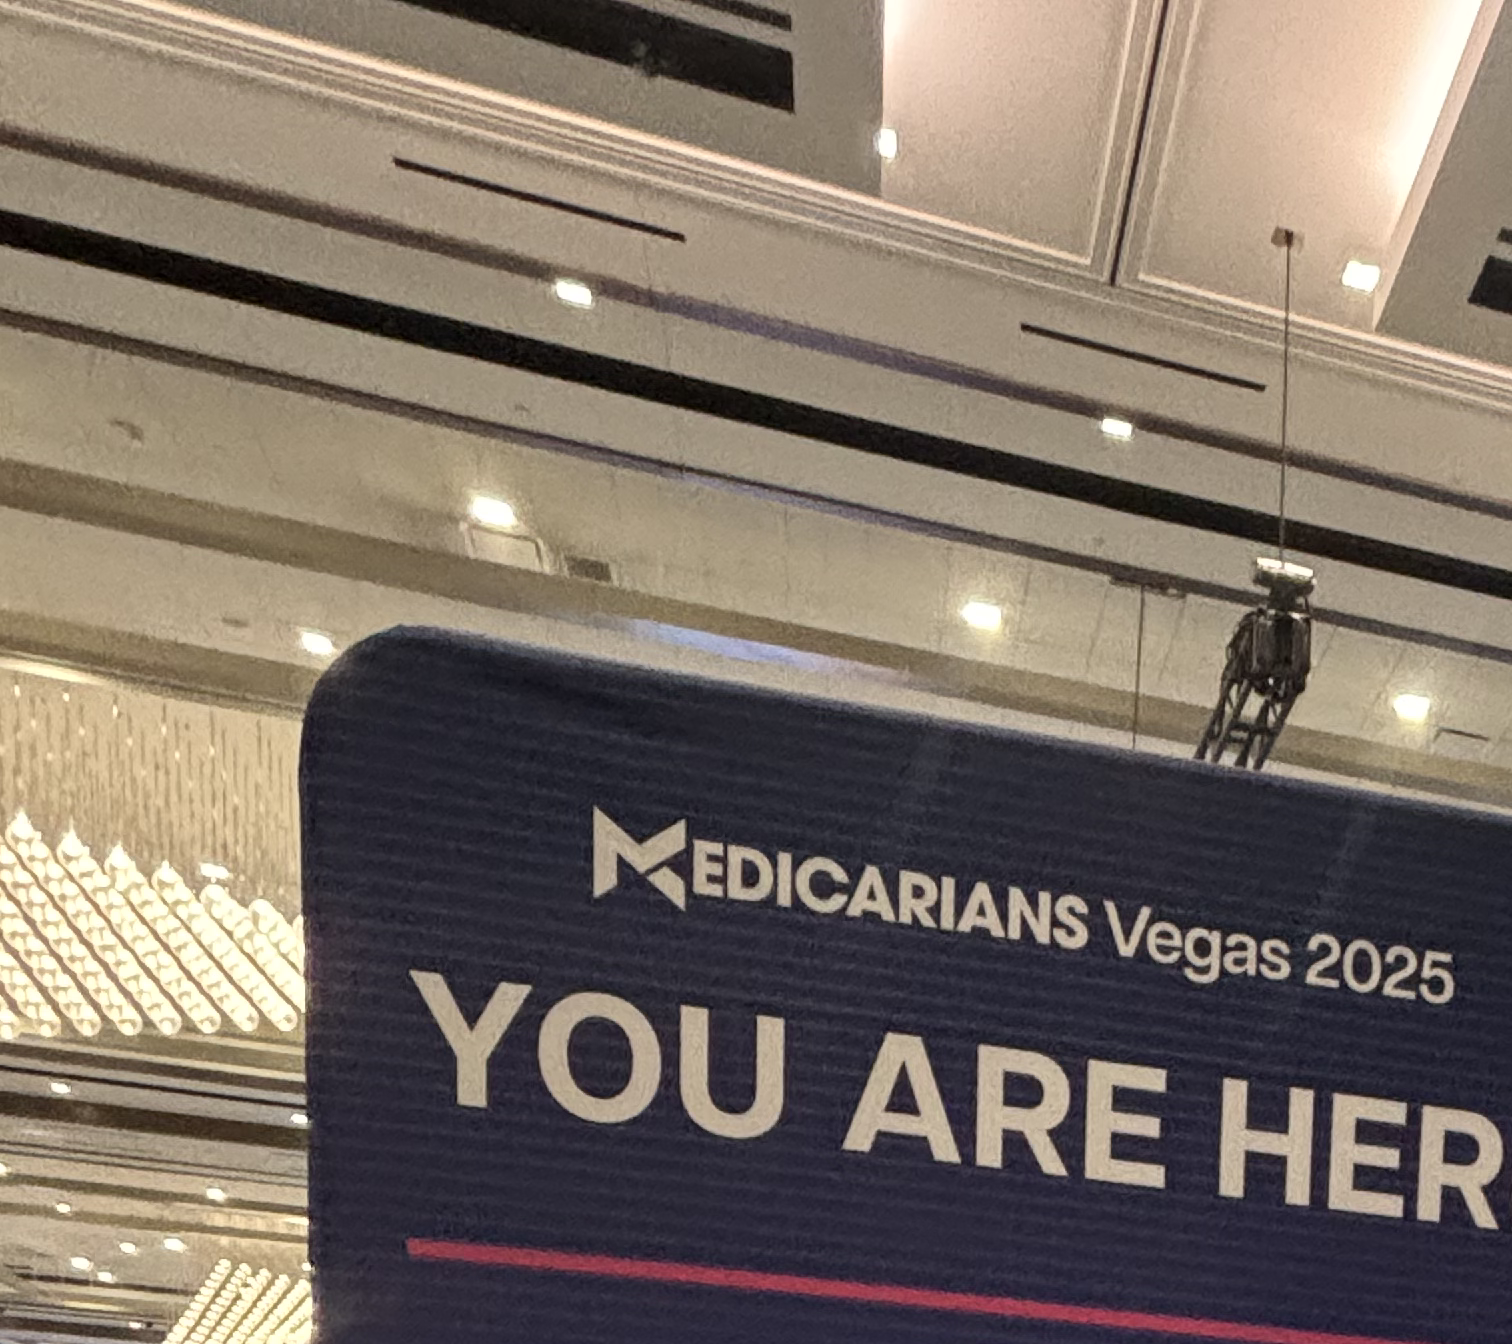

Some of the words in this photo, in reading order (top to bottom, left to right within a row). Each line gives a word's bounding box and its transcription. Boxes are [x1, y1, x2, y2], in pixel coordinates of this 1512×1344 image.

[593, 805, 1089, 950] MEDICARIANS
[1105, 899, 1291, 983] Vegas
[1305, 934, 1455, 1005] 2025
[409, 969, 785, 1139] YOU
[842, 1032, 1168, 1190] ARE
